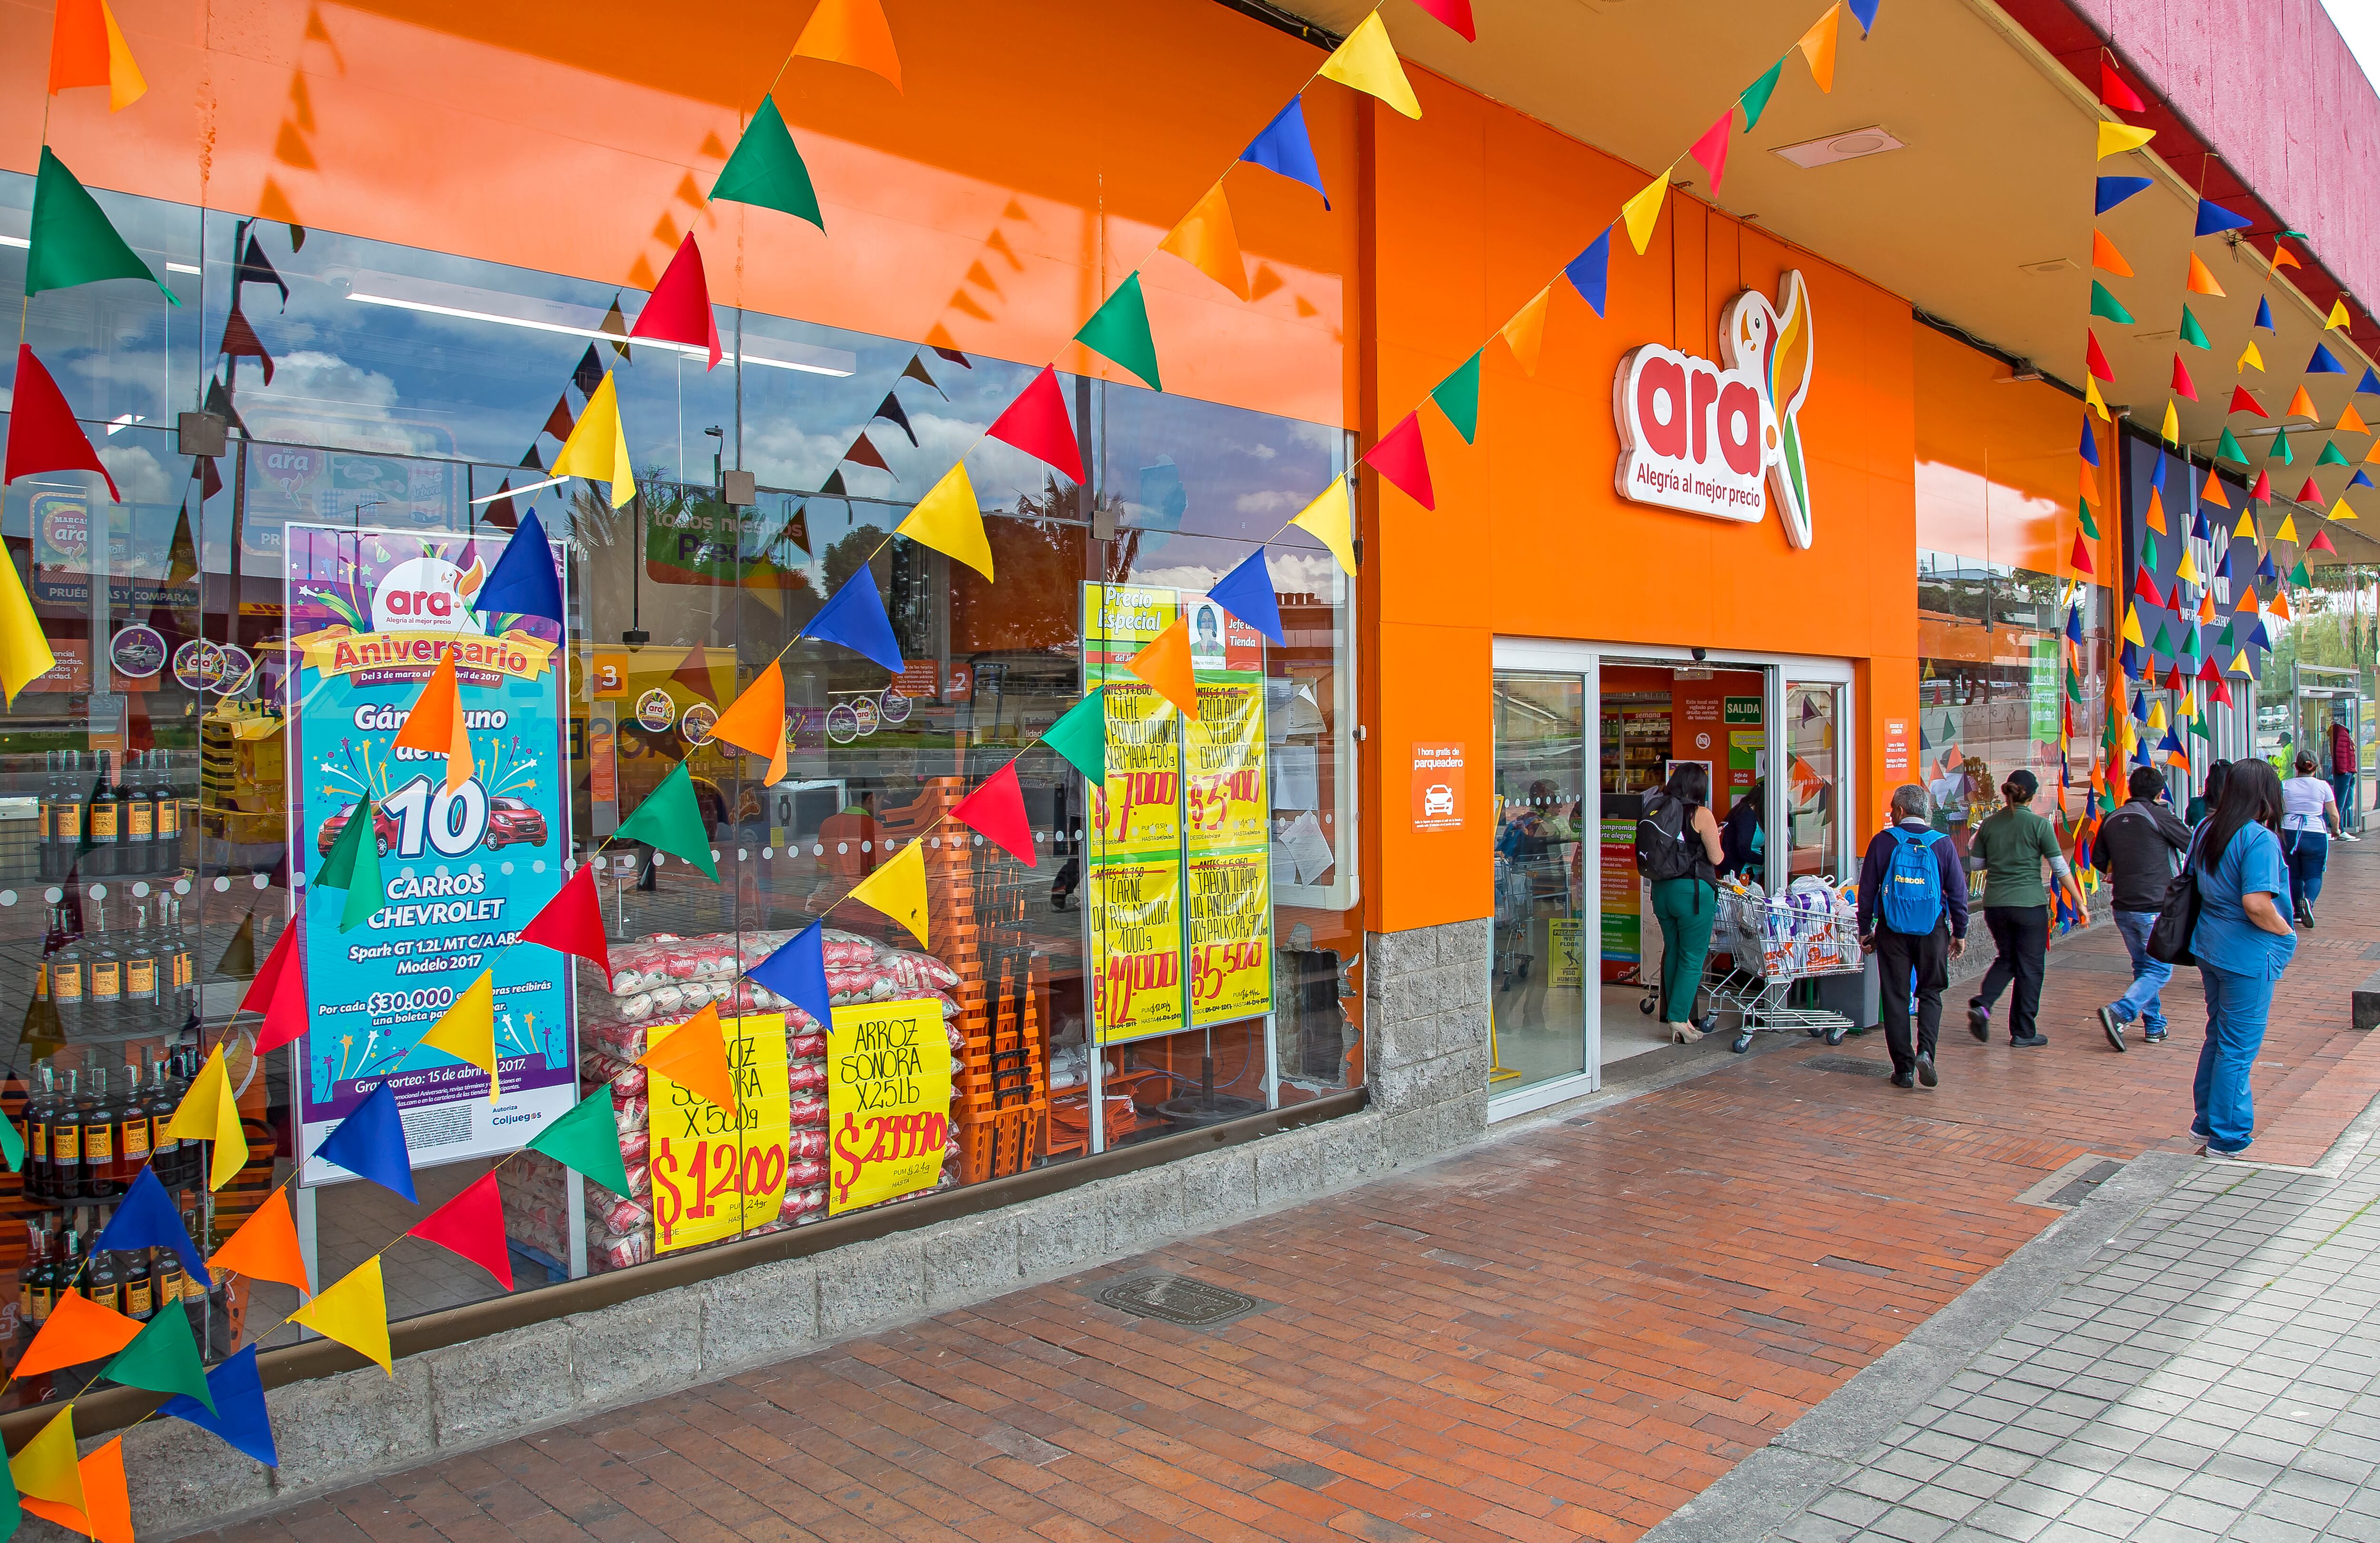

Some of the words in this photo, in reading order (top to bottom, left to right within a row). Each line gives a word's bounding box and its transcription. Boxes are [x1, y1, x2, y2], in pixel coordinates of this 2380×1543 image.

[1637, 357, 1760, 477] ara
[268, 452, 309, 471] ara
[1637, 462, 1679, 493] Alegría
[1683, 472, 1693, 493] al
[1696, 478, 1727, 504] mejor
[1729, 487, 1760, 508] precio
[134, 590, 190, 603] COMPARA
[386, 590, 451, 617] ara
[1104, 586, 1153, 608] Precio
[1097, 609, 1161, 636] Especial
[1229, 618, 1244, 634] Jefe
[1229, 635, 1256, 647] Tienda
[332, 635, 528, 673] Aniversario
[1115, 654, 1124, 662] del
[2033, 657, 2056, 671] compara
[361, 672, 376, 681] Del
[480, 673, 500, 681] 2017
[602, 665, 617, 687] 3
[955, 672, 966, 691] 2
[648, 705, 663, 713] ara
[1107, 696, 1139, 719] LECHE
[1224, 698, 1249, 722] ACEITE
[1727, 703, 1760, 714] SALIDA
[1204, 722, 1247, 744] VEGETAL
[1421, 747, 1434, 756] hora
[1435, 747, 1451, 757] gratis
[1452, 747, 1460, 756] de
[1414, 757, 1464, 771] parqueadero
[385, 777, 486, 856] 10
[1611, 832, 1633, 841] alegría
[387, 872, 486, 899] CARROS
[1195, 870, 1230, 896] JABON
[1894, 874, 1925, 885] Reebok
[1111, 878, 1142, 904] CARNE
[368, 898, 506, 929] CHEVROLET
[1109, 904, 1129, 930] RES
[349, 945, 392, 963] Spark
[394, 941, 414, 956] GT
[416, 940, 441, 954] 1.2L
[443, 936, 467, 952] MT
[467, 934, 494, 951] C/A
[397, 956, 449, 976] Modelo
[449, 954, 482, 969] 2017
[670, 958, 695, 968] Sonora
[318, 1005, 339, 1015] Por
[340, 1002, 366, 1014] cada
[368, 985, 453, 1015] $30.000
[512, 981, 552, 994] recibirás
[373, 1016, 393, 1026] una
[395, 1011, 428, 1024] boleta
[853, 1018, 920, 1054] ARROZ
[388, 1075, 426, 1089] sorteo:
[427, 1070, 441, 1082] 15
[442, 1069, 456, 1081] de
[457, 1065, 482, 1079] abril
[498, 1058, 526, 1072] 2017.
[841, 1047, 922, 1085] SONORA
[791, 1068, 812, 1084] Sonora
[420, 1088, 449, 1098] Aniversario,
[449, 1085, 464, 1094] revisa
[464, 1082, 486, 1091] términos
[433, 1093, 456, 1102] cartelera
[470, 1088, 489, 1097] tiendas
[492, 1104, 518, 1114] Autoriza
[621, 1140, 644, 1157] Sonora
[797, 1165, 819, 1181] Sonora
[892, 1167, 907, 1177] PUM
[892, 1177, 910, 1188] HASTA
